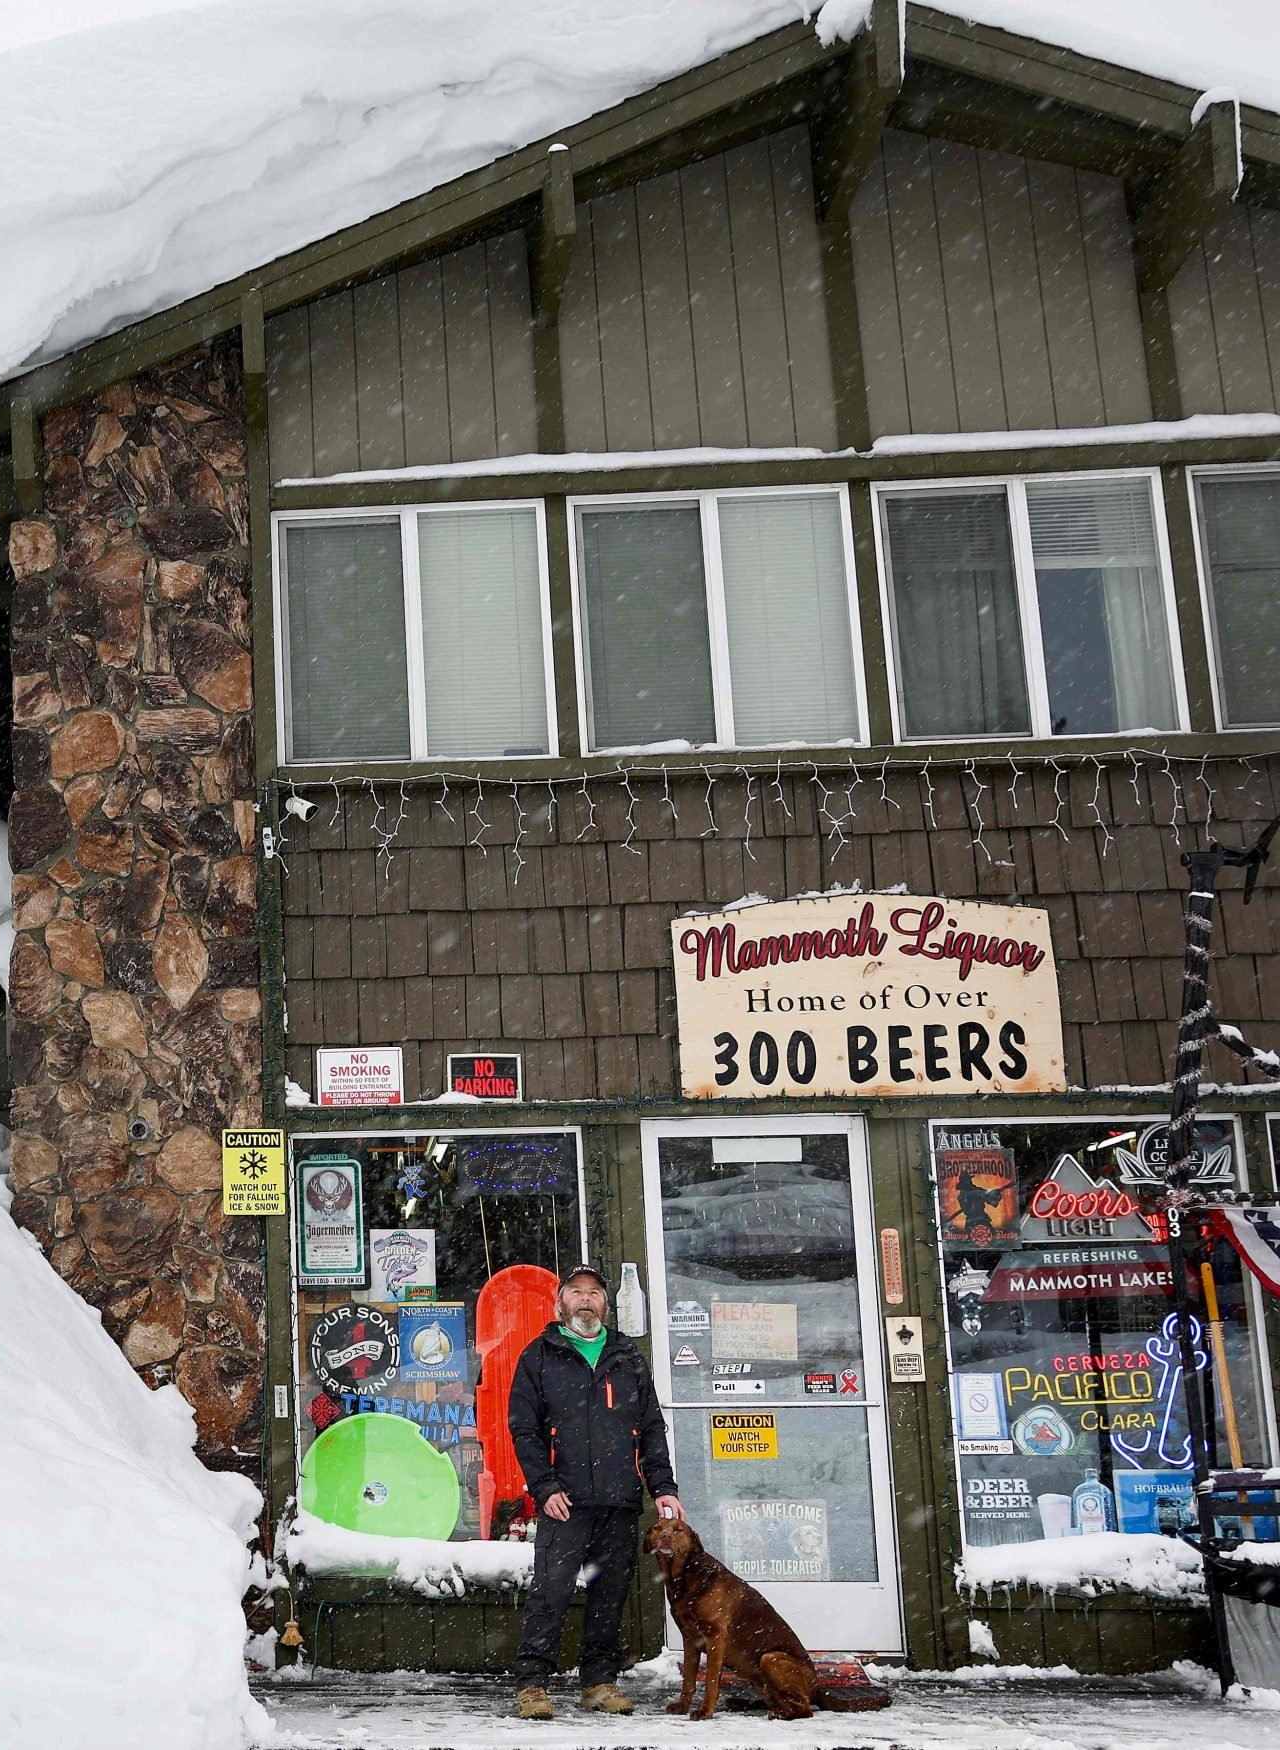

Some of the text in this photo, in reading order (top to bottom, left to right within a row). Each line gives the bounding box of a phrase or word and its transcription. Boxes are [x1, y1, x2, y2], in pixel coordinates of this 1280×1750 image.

[680, 901, 1046, 981] Mammoth Liquor
[746, 984, 989, 1013] Home of Over
[350, 1054, 368, 1064] NO
[714, 1020, 1028, 1086] 300 BEERS
[330, 1066, 391, 1077] SMOKING
[474, 1059, 495, 1077] NO
[455, 1078, 515, 1096] PARKING
[227, 1134, 279, 1147] CAUTION
[936, 1131, 1004, 1151] ANGELS
[465, 1153, 563, 1180] OPEN
[940, 1160, 1012, 1180] BROTHERHOOD
[230, 1183, 277, 1192] WATCH OUT
[229, 1193, 279, 1202] FOR FALLING
[1031, 1180, 1139, 1219] Coors
[229, 1203, 279, 1212] ICE & SNOW
[1049, 1217, 1117, 1237] LIGHT
[384, 1246, 417, 1256] GOLDEN
[1042, 1250, 1138, 1264] REFRESHING
[1010, 1272, 1112, 1292] MAMMOTH
[401, 1308, 459, 1317] NORTH COAST
[671, 1314, 705, 1323] WARNING
[713, 1304, 773, 1321] PLEASE
[312, 1306, 400, 1347] FOUR SONS
[331, 1344, 379, 1365] SONS
[1053, 1352, 1150, 1372] CERVEZA
[406, 1371, 459, 1379] SCRIMSHAW
[714, 1365, 740, 1374] STEP
[316, 1366, 397, 1396] BREWING
[341, 1393, 477, 1427] TEREMANA
[714, 1416, 772, 1428] CAUTION
[1081, 1410, 1156, 1432] CLARA
[728, 1432, 760, 1441] WATCH
[720, 1443, 770, 1452] YOUR STEP
[970, 1444, 999, 1452] Smoking
[968, 1478, 1029, 1493] DEER
[1134, 1483, 1184, 1494] HOFBRÄU
[726, 1502, 822, 1524] DOGS WELCOME
[970, 1511, 1030, 1519] SERVED HERE
[733, 1559, 821, 1576] PEOPLE TOLERATED
